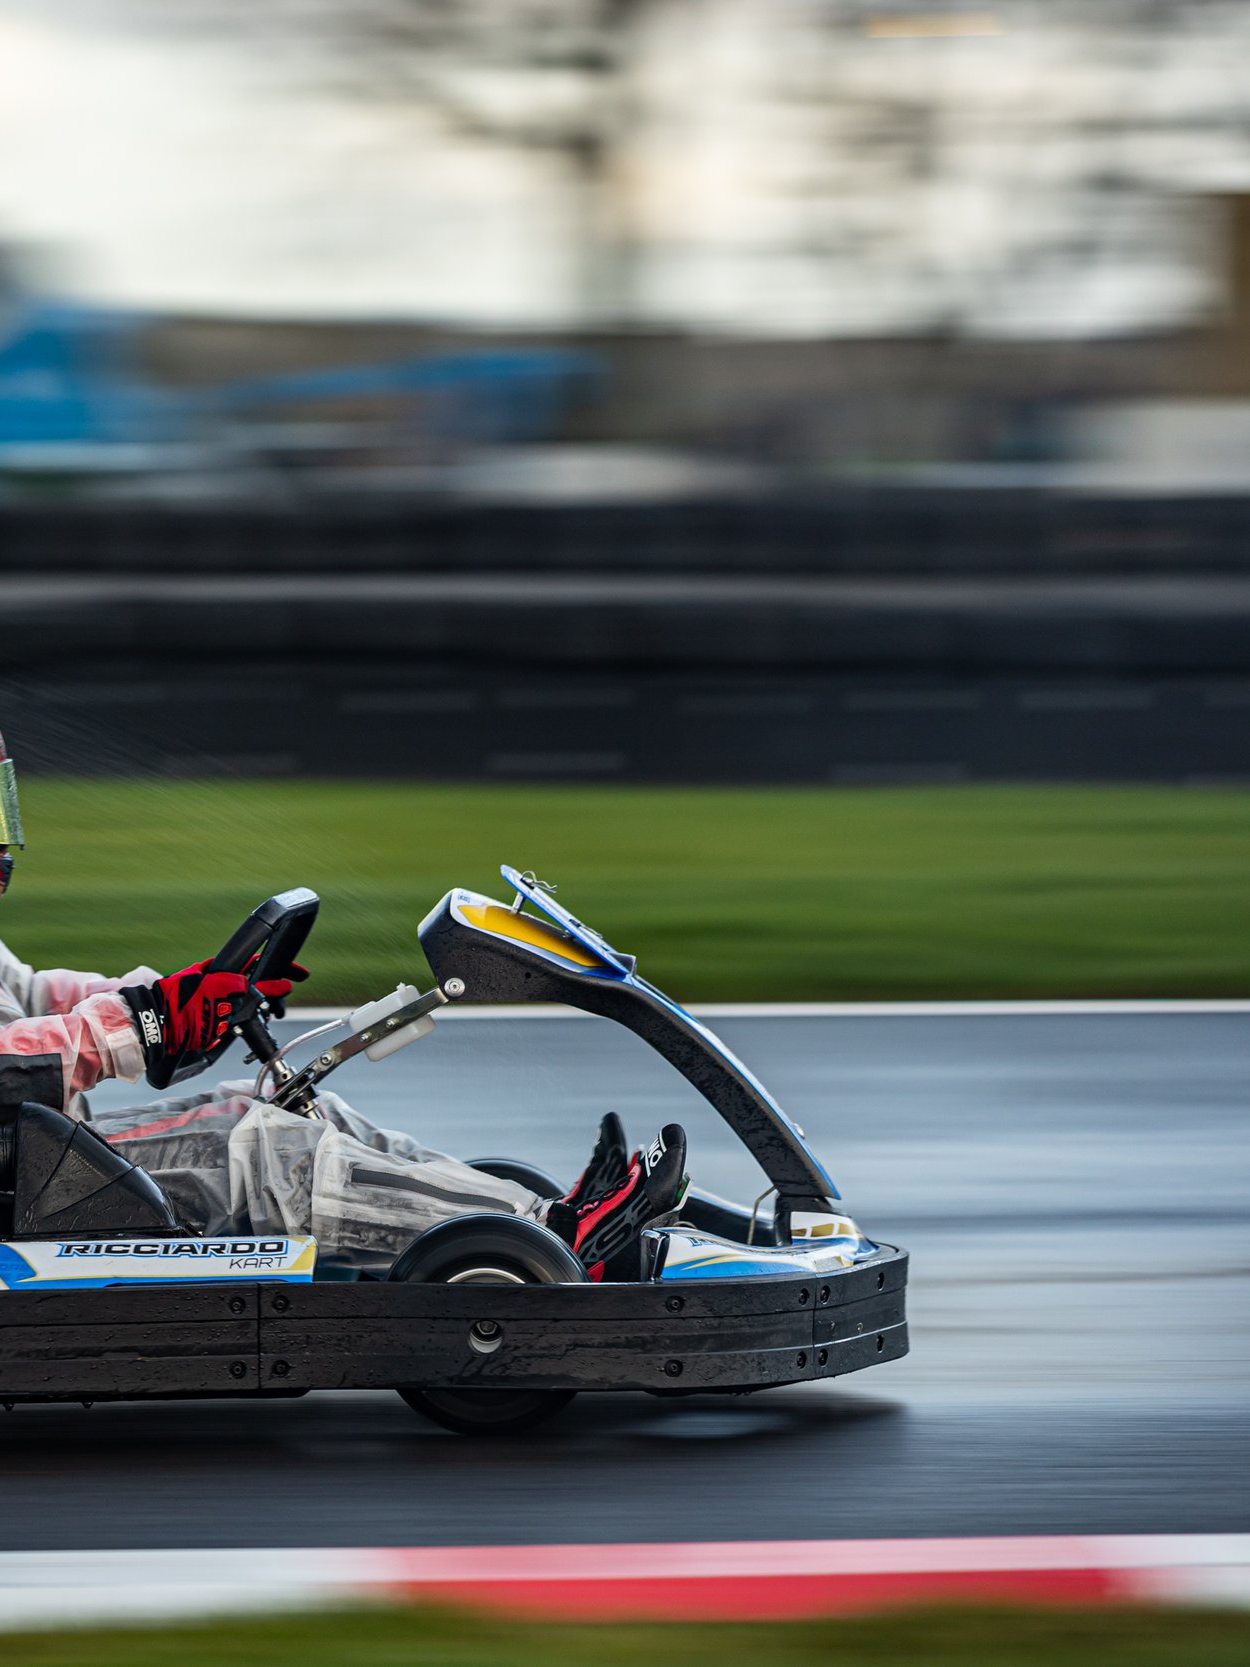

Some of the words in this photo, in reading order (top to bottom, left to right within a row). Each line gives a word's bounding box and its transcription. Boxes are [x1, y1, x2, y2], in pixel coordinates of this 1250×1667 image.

[141, 1010, 159, 1044] OMP
[61, 1240, 287, 1257] RICCIARDO
[229, 1256, 288, 1269] KART
